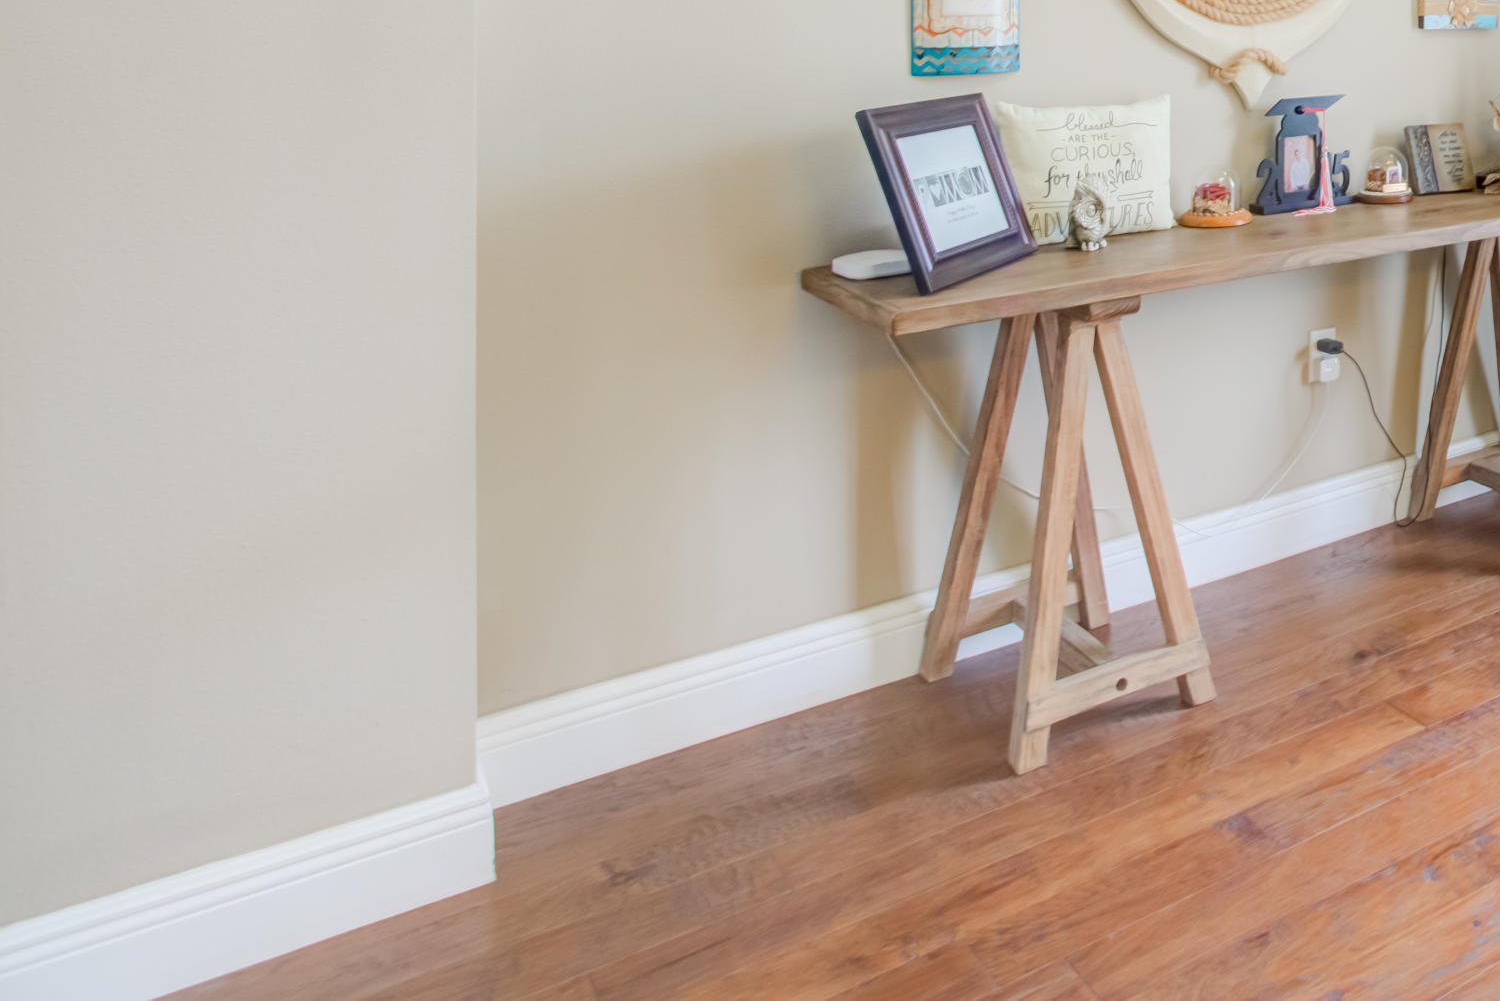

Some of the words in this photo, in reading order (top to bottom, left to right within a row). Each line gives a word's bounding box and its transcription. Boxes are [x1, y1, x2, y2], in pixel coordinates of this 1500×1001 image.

[1056, 111, 1124, 132] blessed
[1050, 142, 1136, 162] CURIOUS,
[1043, 165, 1070, 198] for
[1108, 158, 1144, 184] shall
[1031, 201, 1154, 238] ADVURES
